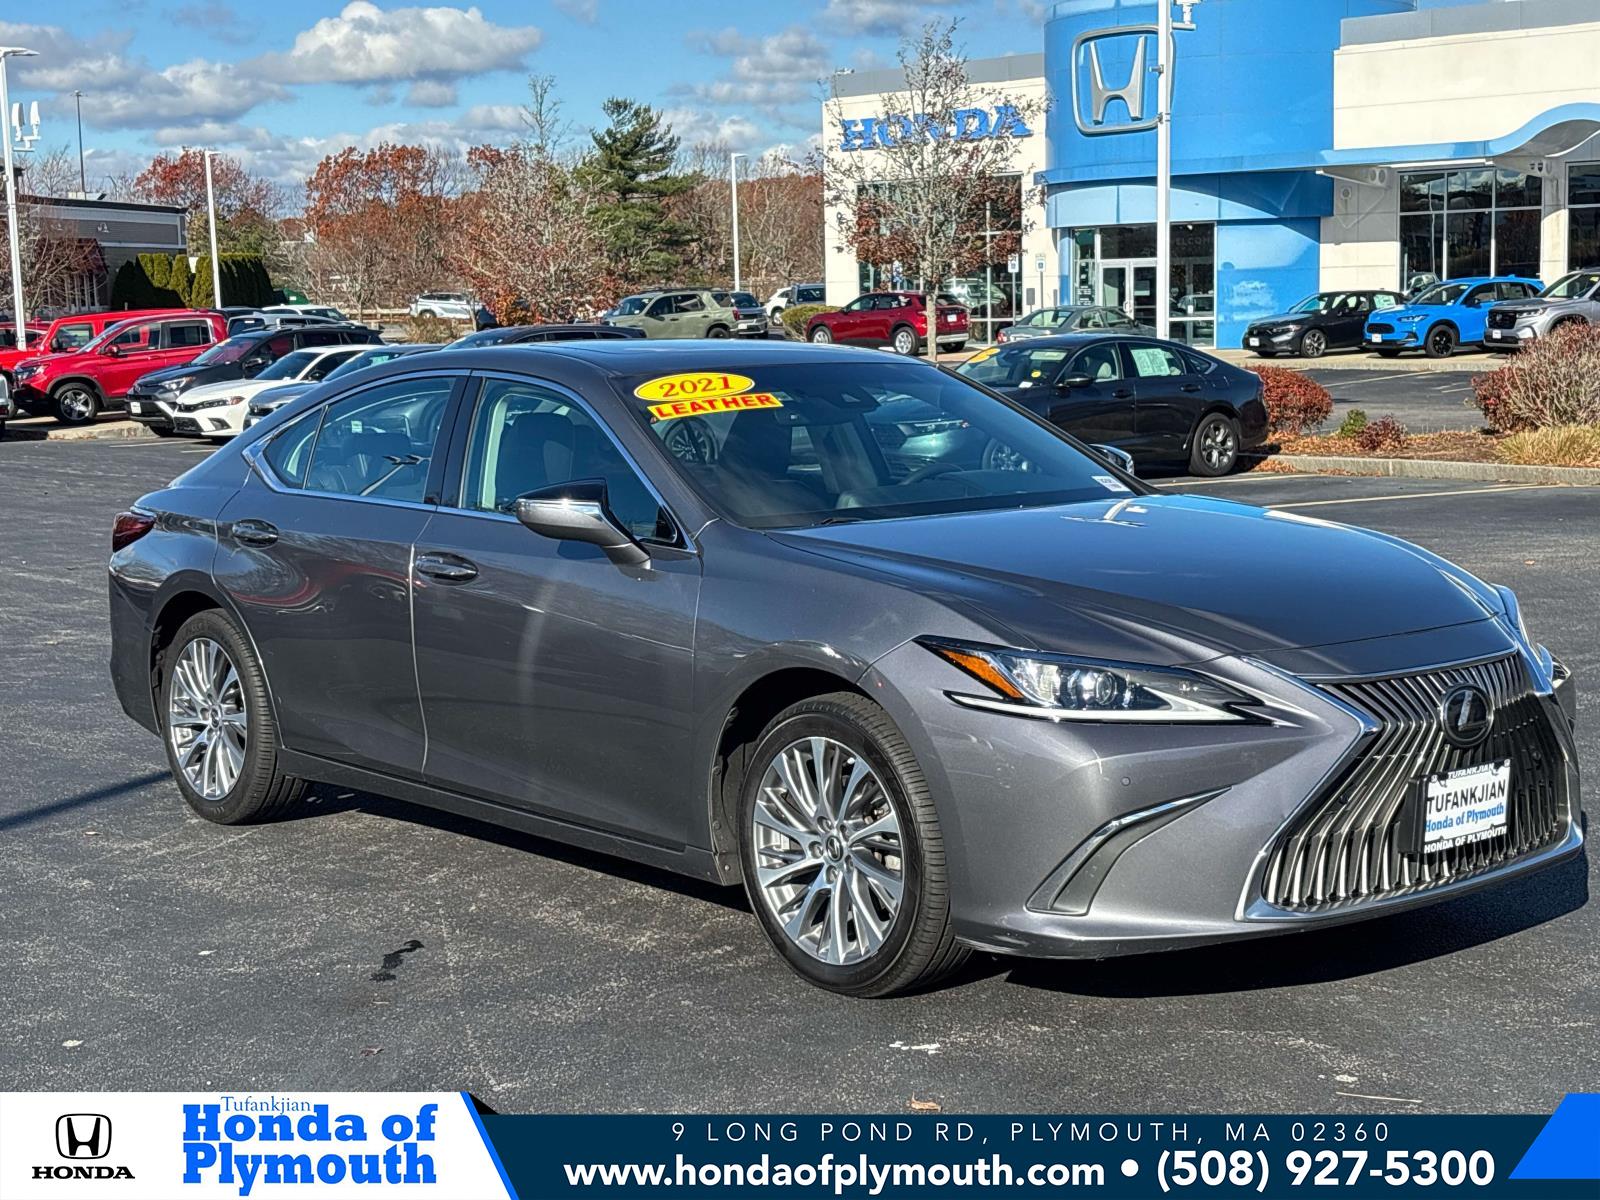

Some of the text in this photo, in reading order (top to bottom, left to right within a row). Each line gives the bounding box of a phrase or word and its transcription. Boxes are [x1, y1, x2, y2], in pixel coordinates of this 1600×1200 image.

[839, 104, 1034, 152] HONDA
[659, 376, 735, 397] 2021
[655, 394, 775, 417] LEATHER
[1447, 762, 1495, 779] TUFANKJIAN
[1427, 779, 1506, 815] TUFANKJIAN
[1425, 802, 1504, 833] Honda of Plymouth
[1424, 825, 1508, 854] HONDA OF PLYMOUTH
